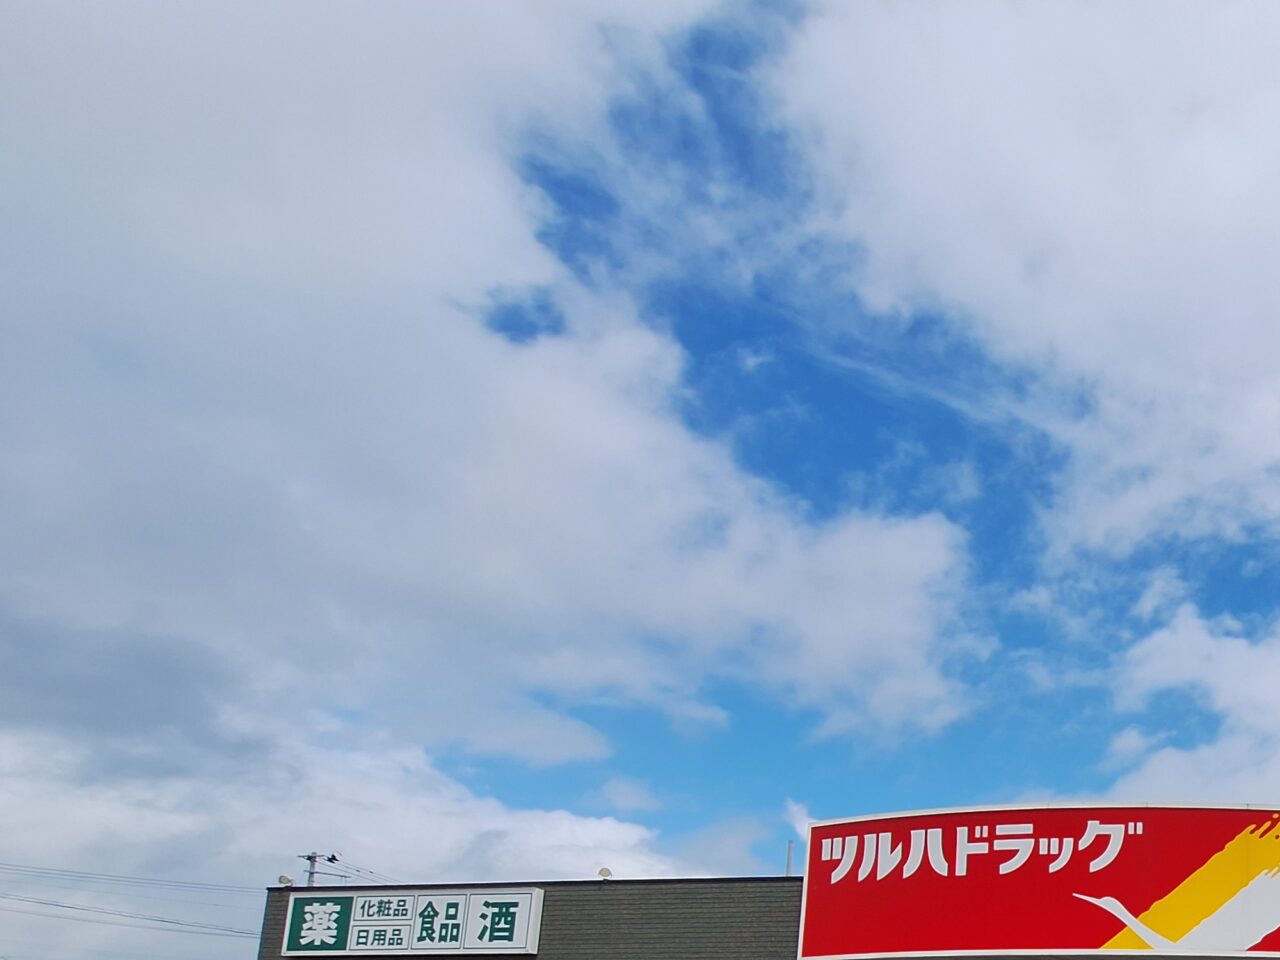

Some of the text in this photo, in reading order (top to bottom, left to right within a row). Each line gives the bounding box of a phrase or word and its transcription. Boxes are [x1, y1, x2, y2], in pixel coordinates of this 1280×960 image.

[820, 820, 1143, 885] ツルハドラッグ
[299, 902, 341, 946] 薬
[360, 899, 408, 918] 化粧品
[416, 900, 461, 943] 食品
[477, 900, 519, 943] 酒
[356, 928, 404, 946] 日用品
